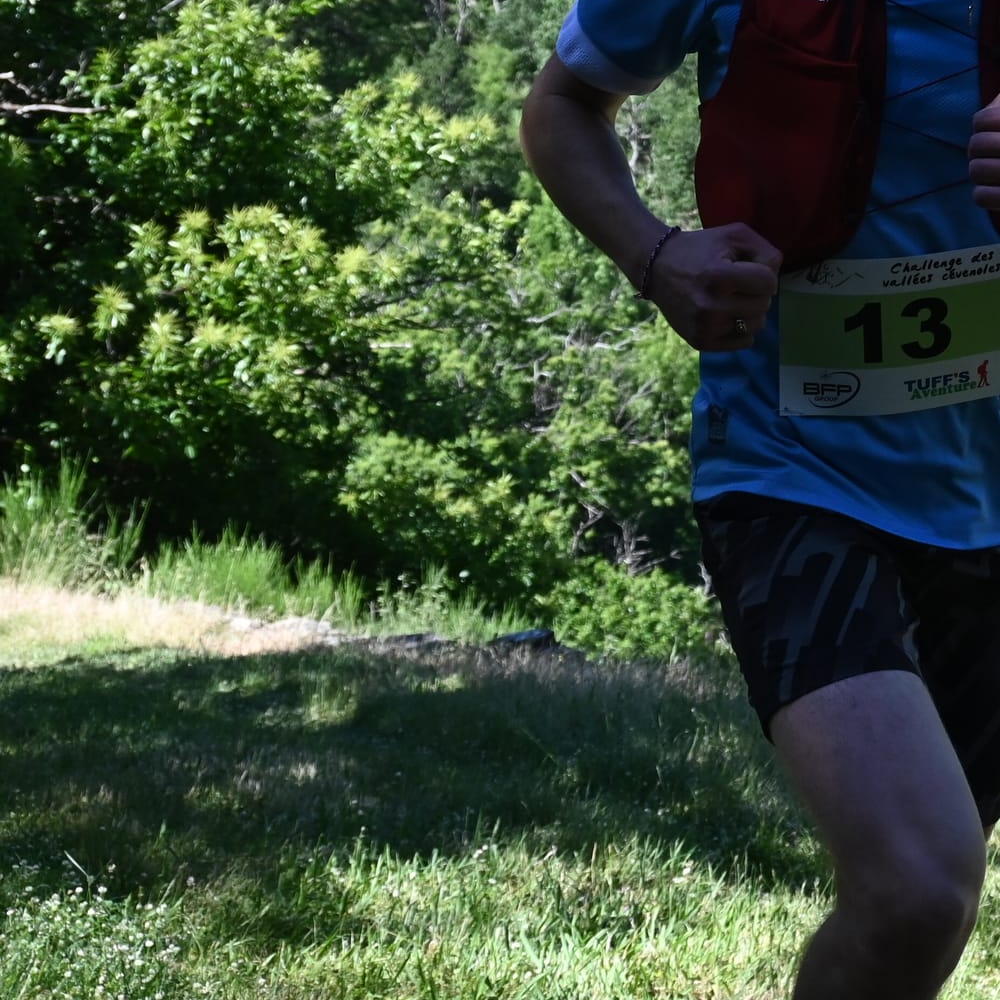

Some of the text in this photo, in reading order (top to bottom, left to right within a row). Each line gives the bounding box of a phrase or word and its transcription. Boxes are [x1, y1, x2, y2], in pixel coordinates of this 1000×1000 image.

[890, 251, 994, 274] Challenge des
[882, 264, 1000, 287] vallées cévenoles
[844, 297, 952, 363] 13
[904, 371, 970, 392] TUFF'S
[909, 380, 977, 400] Aventure
